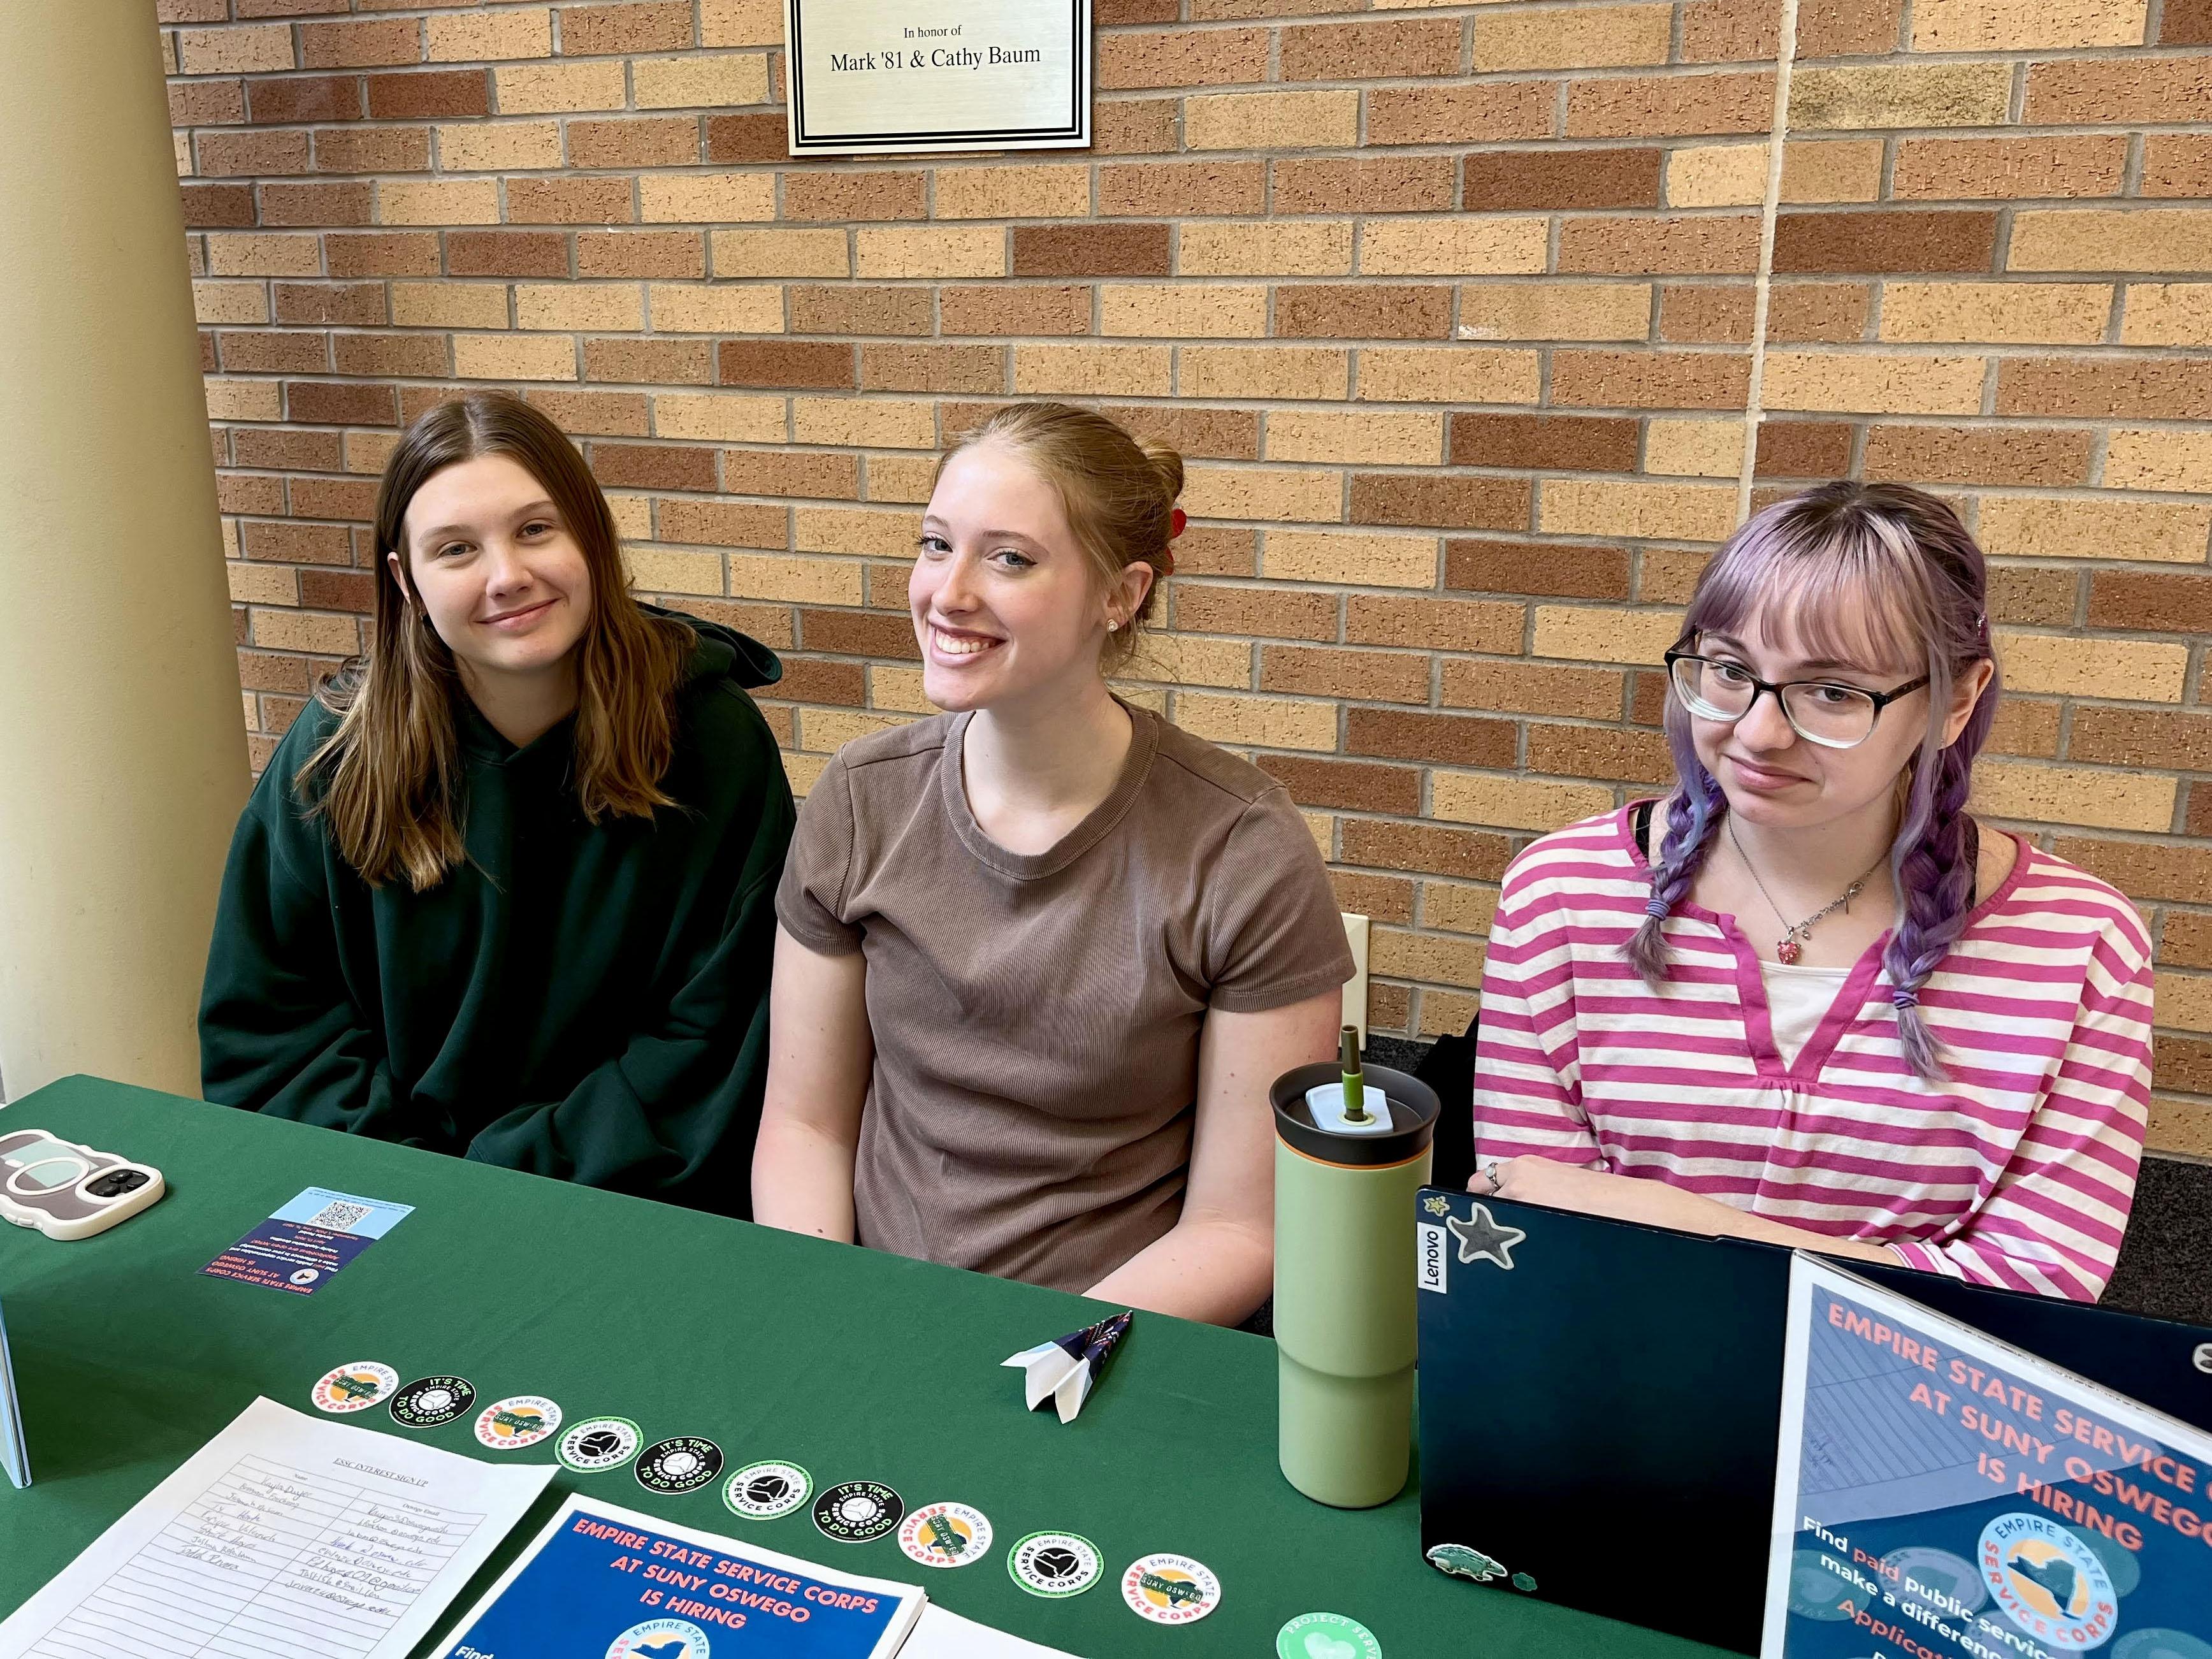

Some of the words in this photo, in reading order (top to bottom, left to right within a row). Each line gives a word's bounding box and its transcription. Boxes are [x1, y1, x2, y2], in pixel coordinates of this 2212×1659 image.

[904, 27, 915, 38] In
[917, 26, 948, 38] honor
[950, 25, 962, 36] of
[830, 53, 876, 71] Mark
[881, 51, 903, 69] '81
[909, 50, 925, 68] &
[931, 48, 983, 70] Cathy
[988, 46, 1041, 64] Baum
[1424, 1231, 1438, 1286] Lenovo
[353, 1365, 388, 1375] EMPIRE
[315, 1368, 345, 1405] SERVICE
[430, 1377, 453, 1386] IT'S
[454, 1380, 472, 1396] TIME
[1828, 1301, 1939, 1372] EMPIRE
[1949, 1359, 2044, 1421] STATE
[2053, 1409, 2196, 1494] SERVICE
[397, 1396, 409, 1407] TO
[399, 1407, 414, 1420] DO
[509, 1399, 547, 1408] EMPIRE
[416, 1411, 454, 1423] GOOD
[479, 1405, 503, 1444] SERVICE
[1909, 1382, 1951, 1416] AT
[1962, 1405, 2055, 1465] SUNY
[581, 1423, 614, 1434] EMPIRE
[615, 1425, 632, 1442] STATE
[566, 1435, 590, 1464] SERVICE
[594, 1444, 630, 1464] CORPS
[659, 1439, 684, 1452] IT'S
[688, 1439, 713, 1454] TIME
[660, 1446, 687, 1458] EMPIRE
[688, 1447, 705, 1460] STATE
[354, 1462, 396, 1479] INTEREST
[396, 1474, 416, 1486] SIGN
[640, 1466, 653, 1479] TO
[651, 1477, 669, 1488] DO
[674, 1470, 712, 1488] GOOD
[744, 1467, 778, 1480] EMPIRE
[781, 1469, 800, 1485] STATE
[734, 1481, 762, 1510] SERVICE
[767, 1488, 800, 1510] CORPS
[837, 1484, 862, 1495] IT'S
[867, 1484, 893, 1500] TIME
[839, 1491, 867, 1502] EMPIRE
[867, 1493, 885, 1507] STATE
[1978, 1453, 2006, 1484] IS
[2018, 1472, 2144, 1551] HIRING
[818, 1510, 832, 1523] TO
[829, 1523, 849, 1535] DO
[854, 1518, 892, 1536] GOOD
[832, 1502, 857, 1527] SERVICE
[903, 1506, 946, 1542] SERVICE
[953, 1507, 986, 1532] EMPIRE
[907, 1545, 956, 1563] CORPS
[1037, 1539, 1074, 1547] EMPIRE
[1075, 1546, 1092, 1566] STATE
[1995, 1519, 2056, 1539] EMPIRE
[2063, 1536, 2108, 1590] STATE
[572, 1518, 649, 1551] EMPIRE
[649, 1538, 712, 1570] STATE
[713, 1558, 802, 1595] SERVICE
[798, 1585, 878, 1615] CORPS
[1021, 1546, 1045, 1585] SERVICE
[1048, 1570, 1088, 1588] CORPS
[1149, 1558, 1196, 1571] EMPIRE
[1196, 1570, 1215, 1597] STATE
[609, 1556, 641, 1577] AT
[642, 1563, 706, 1592] SUNY
[708, 1583, 811, 1624] OSWEGO
[1126, 1565, 1154, 1614] SERVICE
[1158, 1600, 1210, 1620] CORPS
[1803, 1516, 1847, 1553] Find
[1853, 1547, 1900, 1582] paid
[1904, 1577, 1974, 1623] public
[1978, 1618, 2057, 1659] servic
[1984, 1540, 2046, 1635] SERVICE
[2055, 1601, 2113, 1642] CORPS
[639, 1589, 664, 1607] IS
[665, 1597, 748, 1630] HIRING
[1821, 1554, 1879, 1596] make
[1883, 1591, 1896, 1607] a
[1902, 1602, 2007, 1659] differenc
[1286, 1614, 1350, 1634] PROJECT
[633, 1621, 684, 1636] EMPIRE
[684, 1626, 706, 1655] STATE
